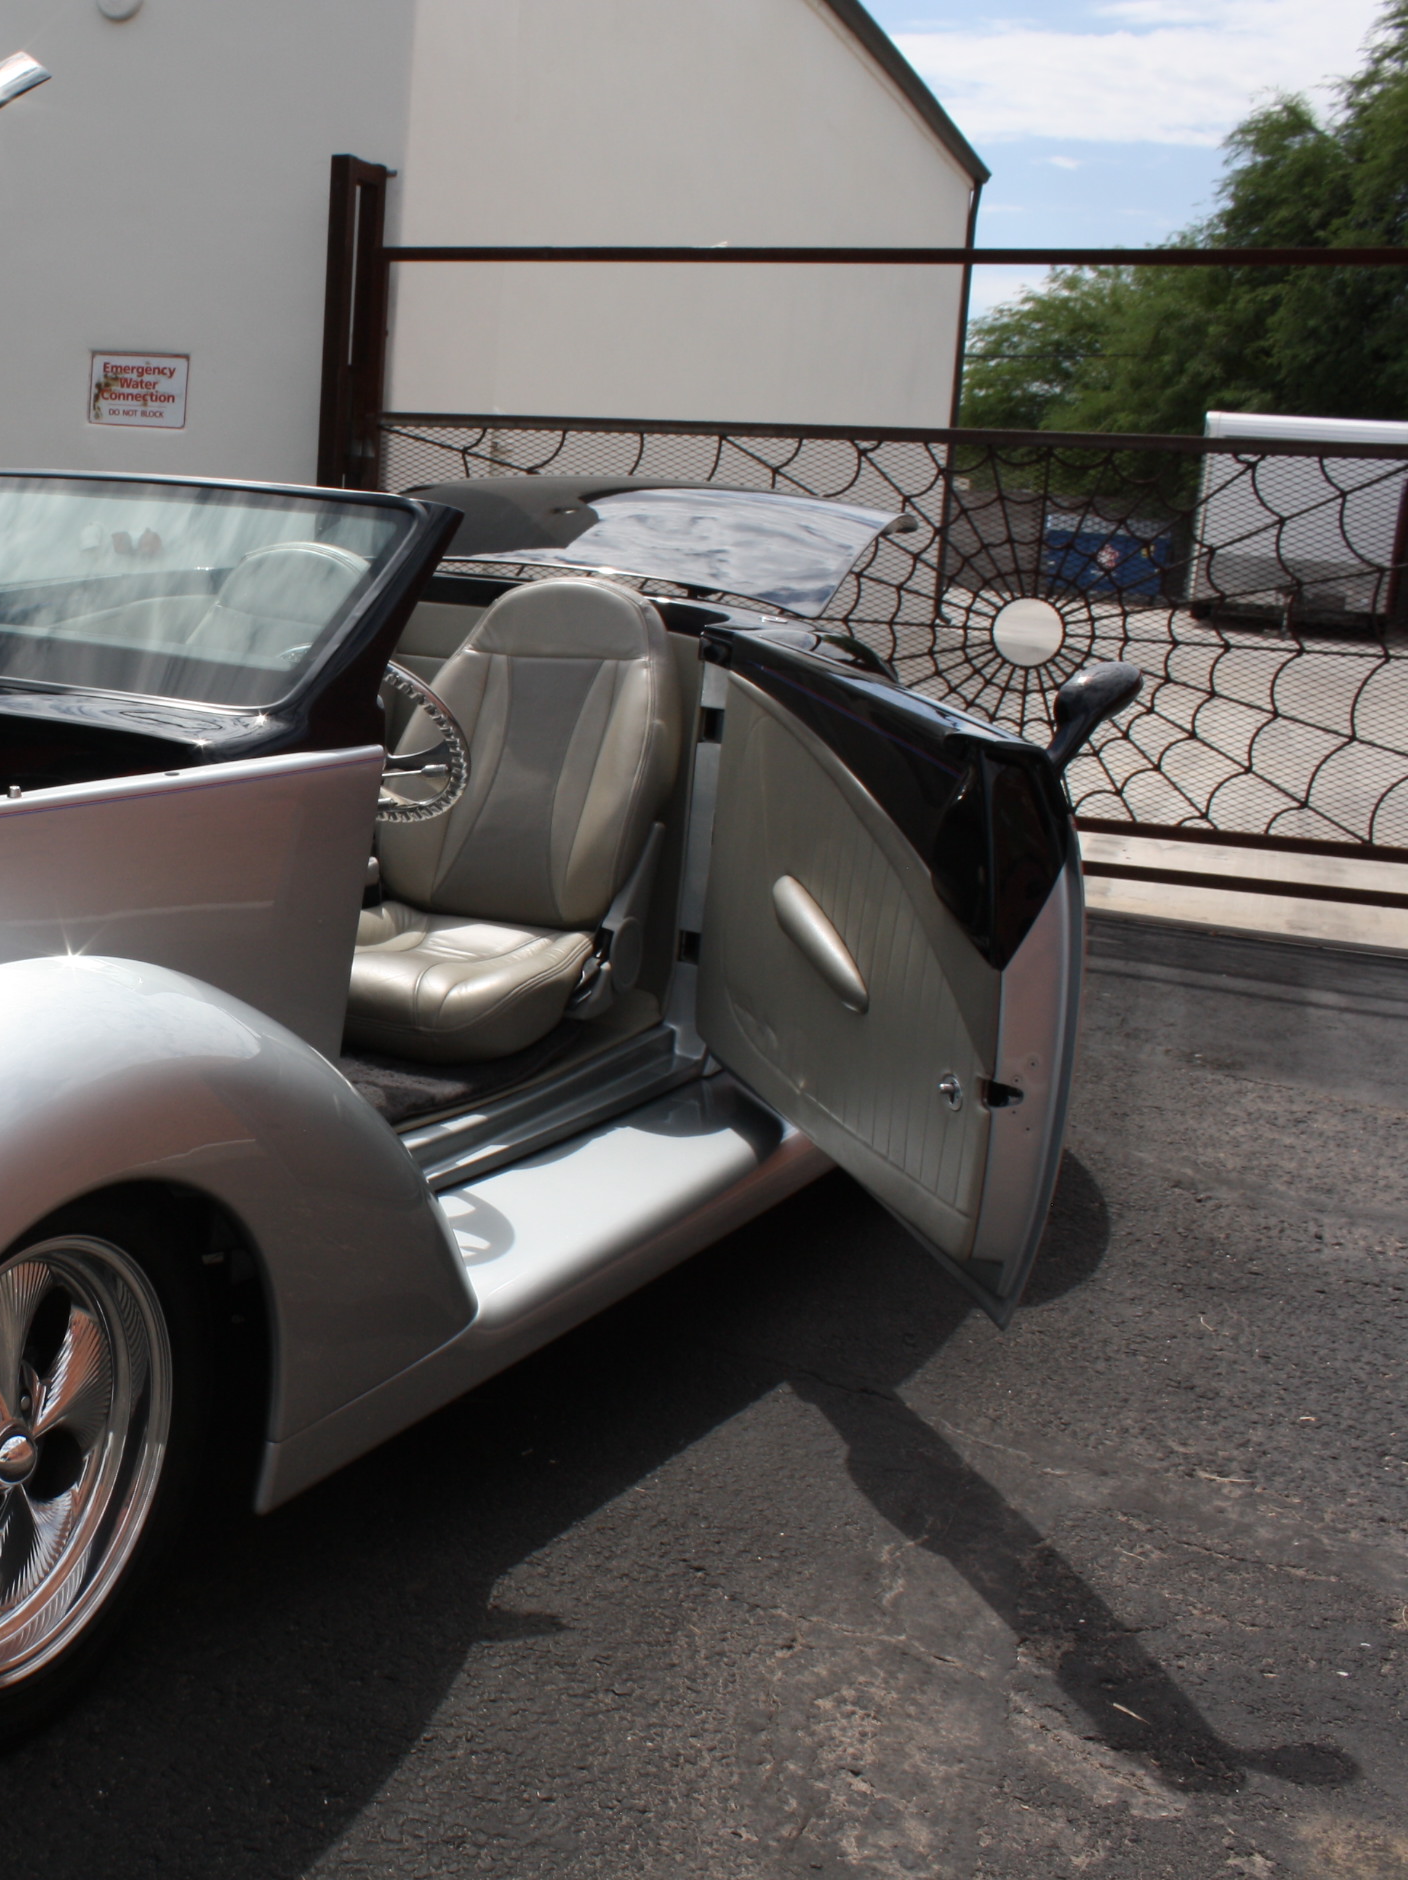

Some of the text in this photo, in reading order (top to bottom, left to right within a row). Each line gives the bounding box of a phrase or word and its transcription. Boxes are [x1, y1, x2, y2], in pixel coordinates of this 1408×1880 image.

[103, 362, 176, 378] Emergency
[119, 378, 159, 390] Water
[100, 390, 176, 403] Connection
[108, 408, 165, 418] DO NOT BLOCK
